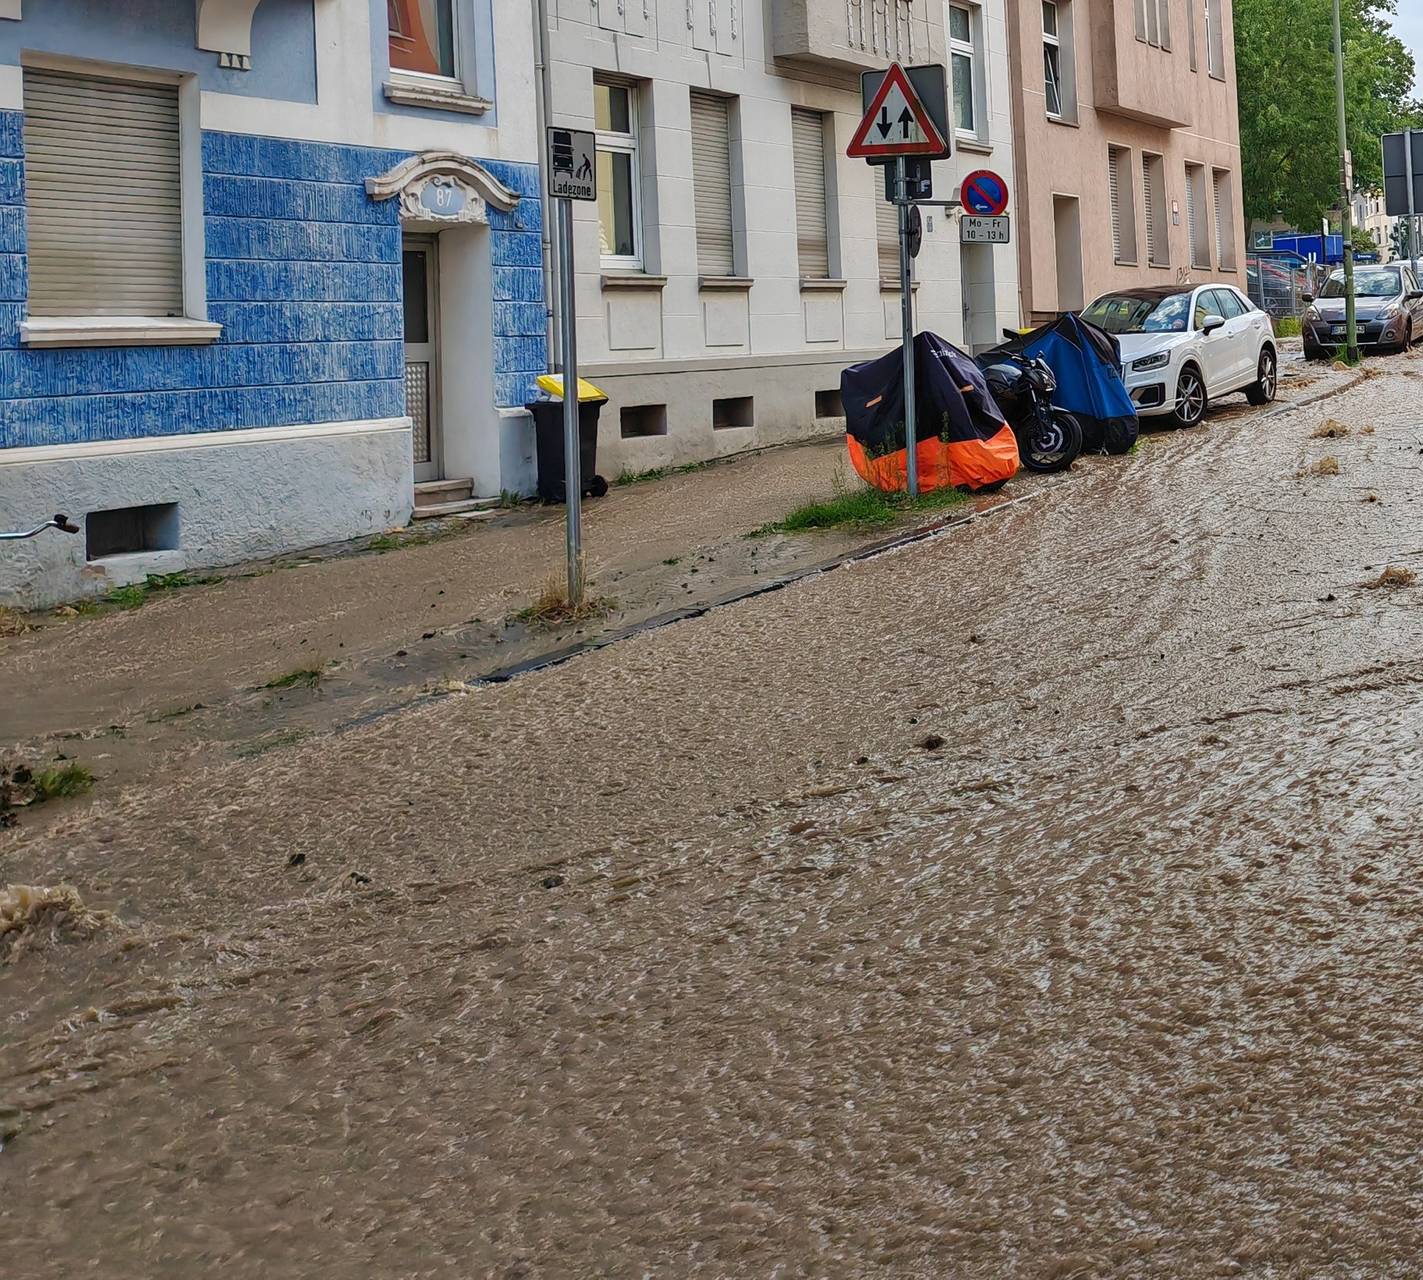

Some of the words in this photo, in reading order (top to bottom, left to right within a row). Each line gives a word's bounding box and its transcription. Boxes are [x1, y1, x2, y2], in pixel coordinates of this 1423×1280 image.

[553, 179, 592, 197] Ladezone
[436, 188, 452, 207] 87
[969, 218, 982, 228] Mo
[992, 218, 1001, 228] Fr
[967, 230, 976, 240] 10
[987, 230, 996, 240] 13
[999, 231, 1004, 240] h
